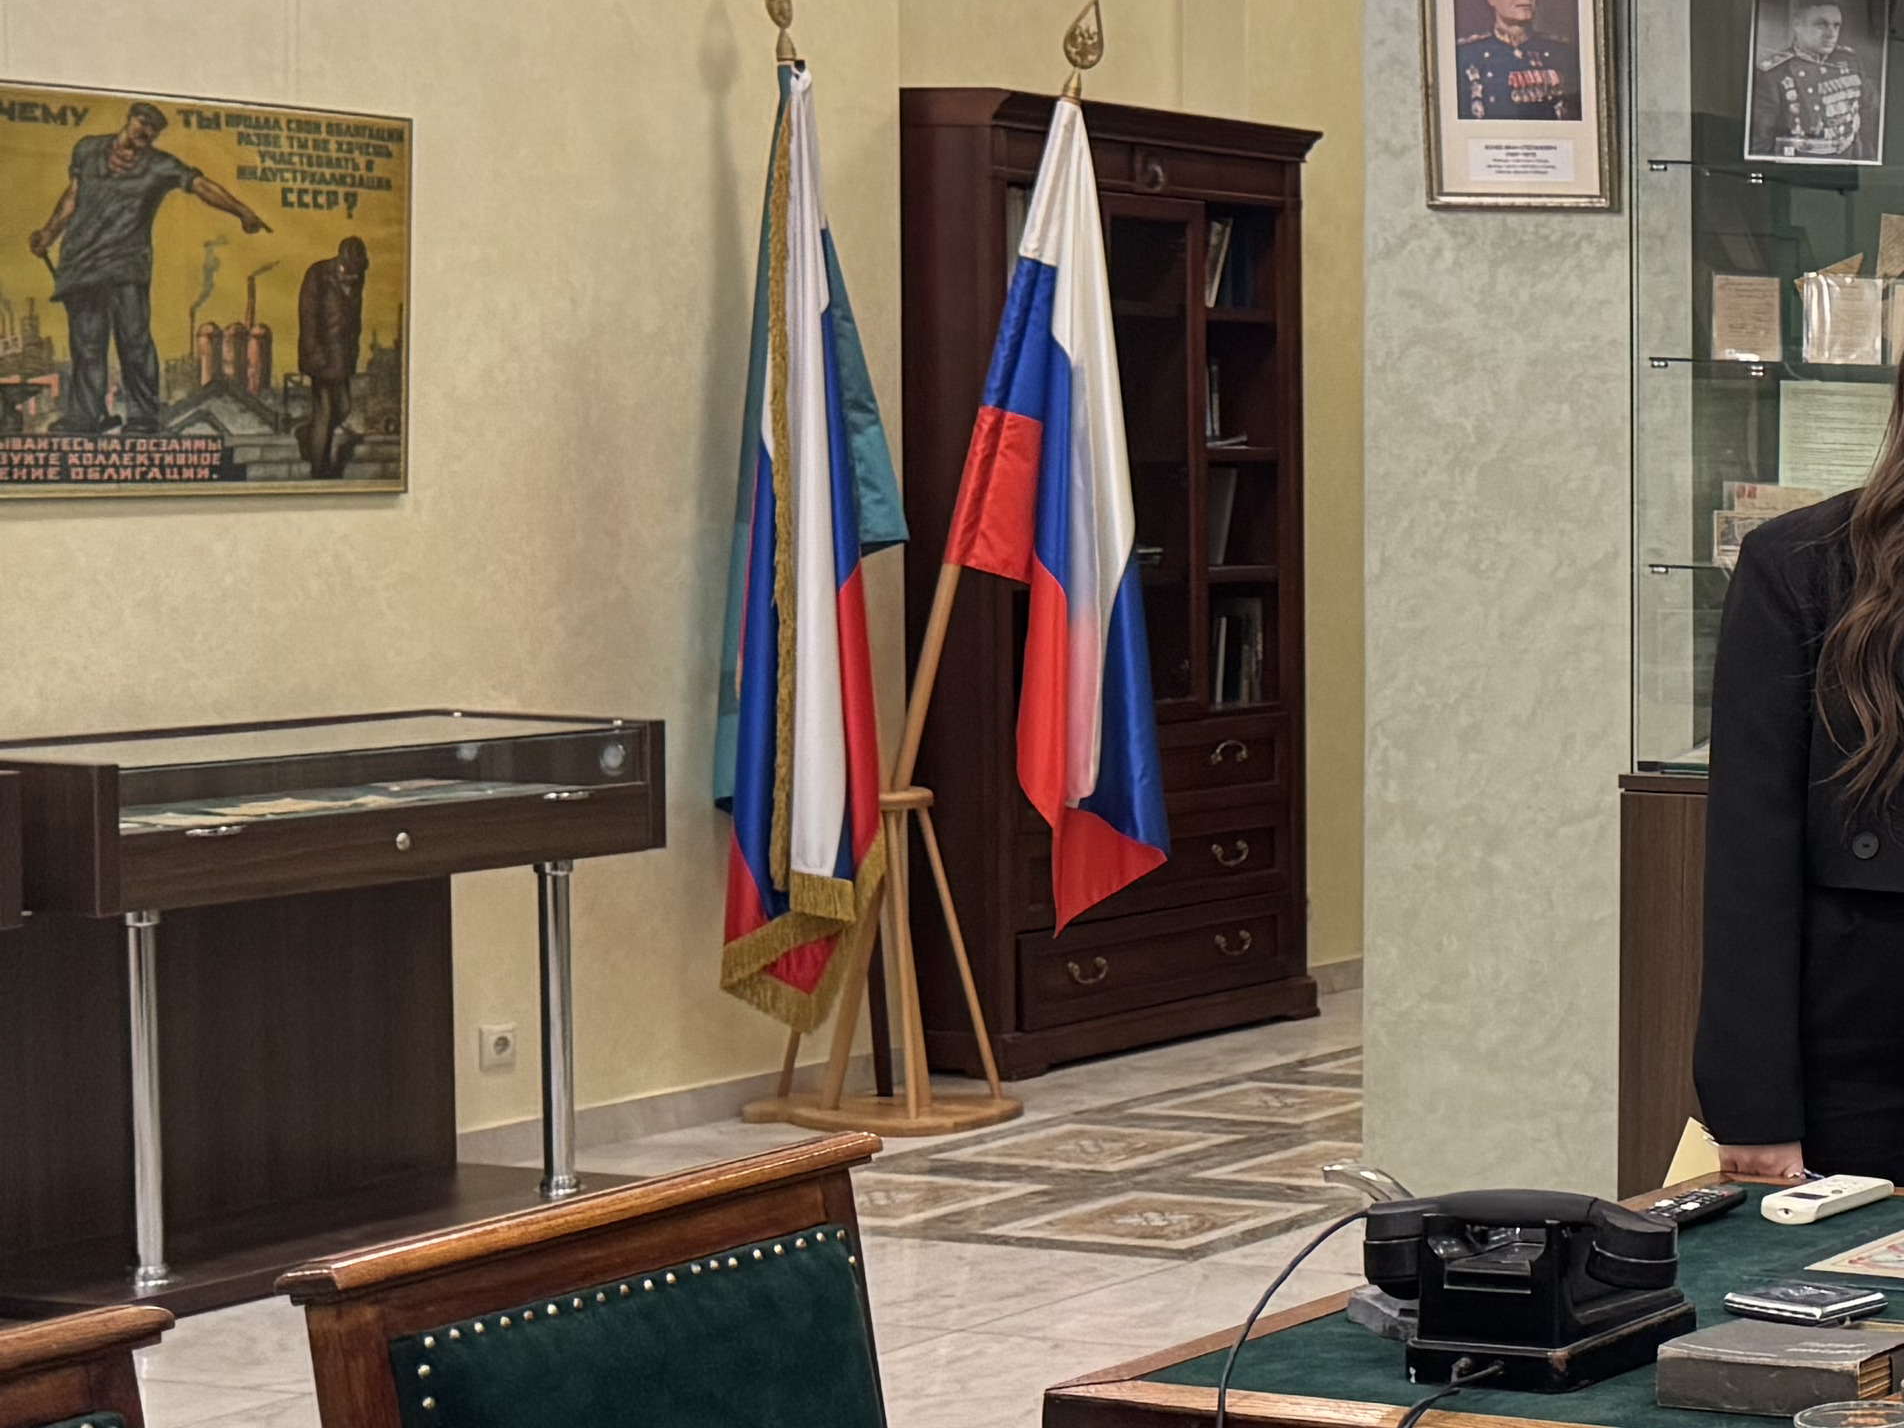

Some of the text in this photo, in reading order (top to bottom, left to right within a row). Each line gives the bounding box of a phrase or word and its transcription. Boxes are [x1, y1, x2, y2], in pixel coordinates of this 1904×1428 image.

[177, 109, 221, 131] ТЫ
[97, 438, 121, 452] НА
[68, 453, 221, 466] КОЛЛЕКТИВНОЕ
